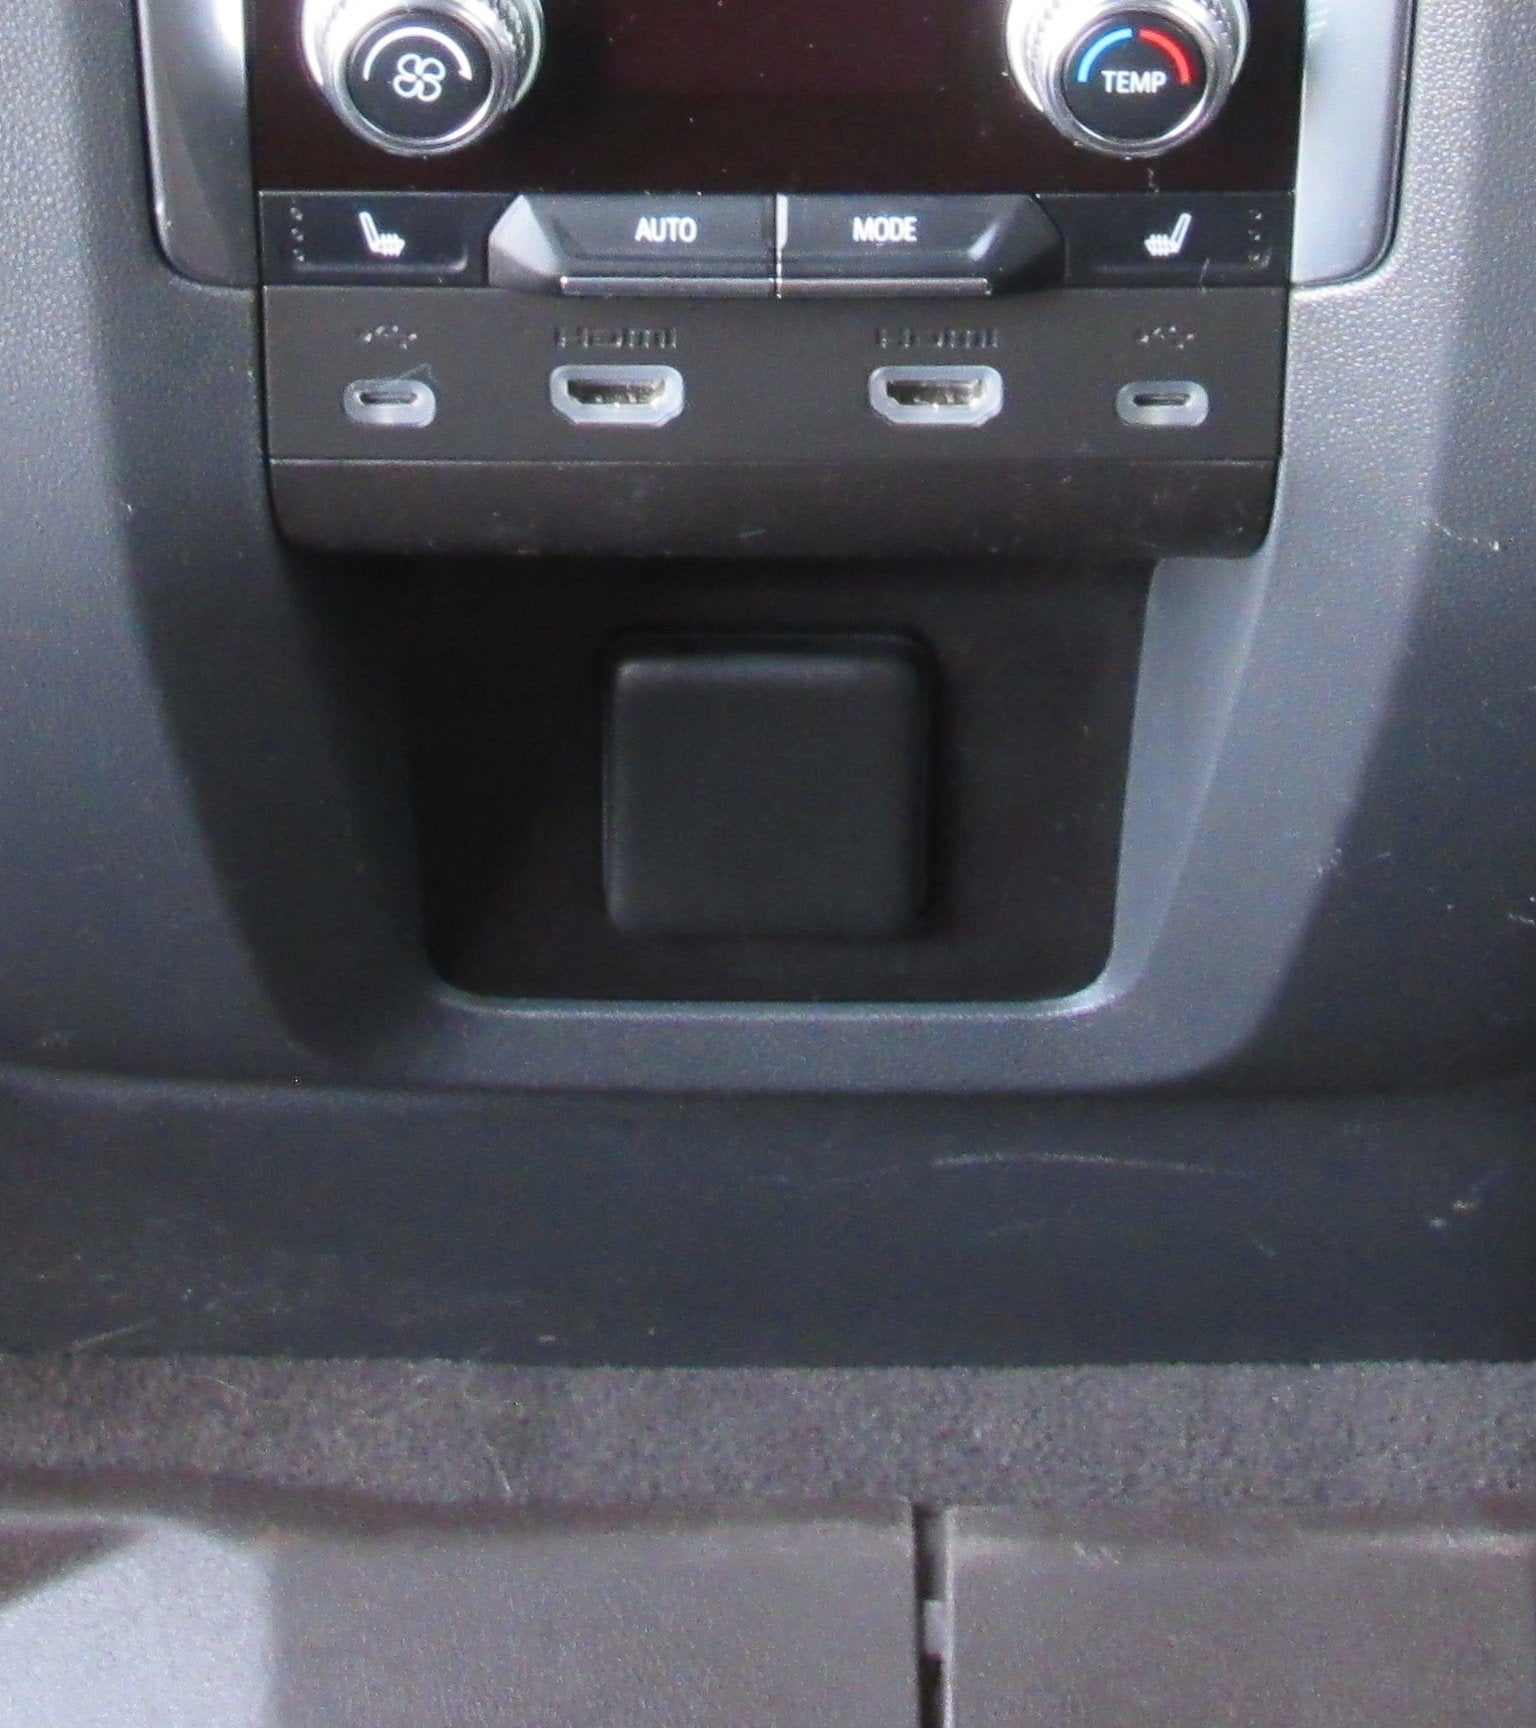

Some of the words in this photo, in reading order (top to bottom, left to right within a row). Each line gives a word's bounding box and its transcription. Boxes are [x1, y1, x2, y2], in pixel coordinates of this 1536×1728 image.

[1101, 70, 1167, 94] TEMP
[635, 216, 697, 242] AUTO
[852, 216, 918, 242] MODE
